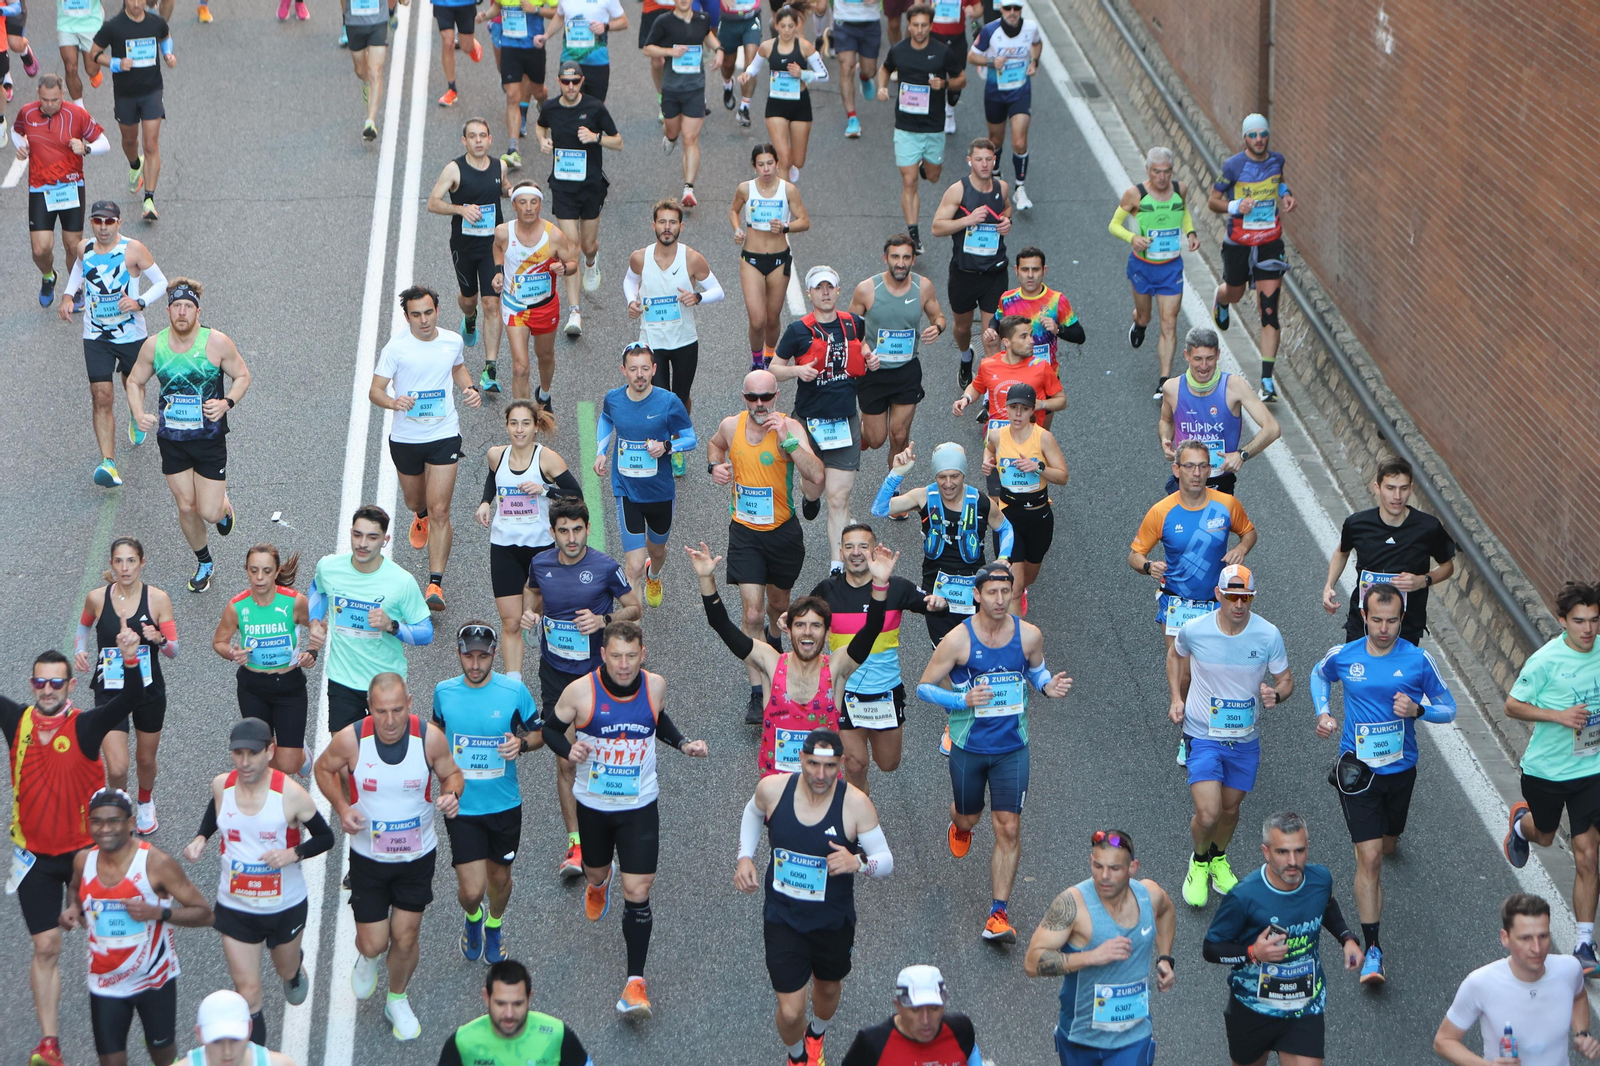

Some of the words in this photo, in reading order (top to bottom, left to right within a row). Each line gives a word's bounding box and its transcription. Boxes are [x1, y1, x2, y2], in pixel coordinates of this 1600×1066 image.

[527, 274, 547, 282] ZURICH
[101, 294, 121, 303] ZURICH
[891, 330, 912, 338] ZURICH
[421, 391, 442, 399] ZURICH
[1181, 420, 1224, 434] FILÍPIDES
[744, 488, 767, 496] ZURICH
[510, 500, 524, 508] 8408
[950, 577, 973, 585] ZURICH
[350, 601, 375, 610] ZURICH
[1184, 600, 1208, 609] ZRICH
[350, 614, 365, 623] 4345
[244, 622, 288, 635] PORTUGAL
[260, 638, 286, 647] ZURICH
[557, 635, 573, 643] 4734
[991, 675, 1017, 683] ZURICH
[1228, 700, 1252, 708] ZURICH
[863, 706, 879, 714] 9728
[601, 723, 651, 735] RUNNERS
[1371, 725, 1398, 734] ZURICH
[471, 739, 500, 747] ZURICH
[471, 753, 488, 761] 4732
[1372, 749, 1391, 758] TOMAS
[607, 767, 635, 776] ZURICH
[605, 781, 623, 789] 6530
[389, 821, 416, 831] ZURICH
[390, 837, 407, 845] 7983
[791, 857, 821, 867] ZURICH
[789, 870, 807, 880] 6090
[247, 880, 262, 888] 838
[783, 877, 815, 891] BULLDOG75
[1281, 965, 1309, 976] ZURICH
[1116, 985, 1142, 996] ZURICH
[1279, 982, 1297, 991] 2850
[1268, 990, 1306, 999] MINI-MARTA
[1115, 1003, 1132, 1013] 6307
[1110, 1013, 1135, 1022] BELLIDO
